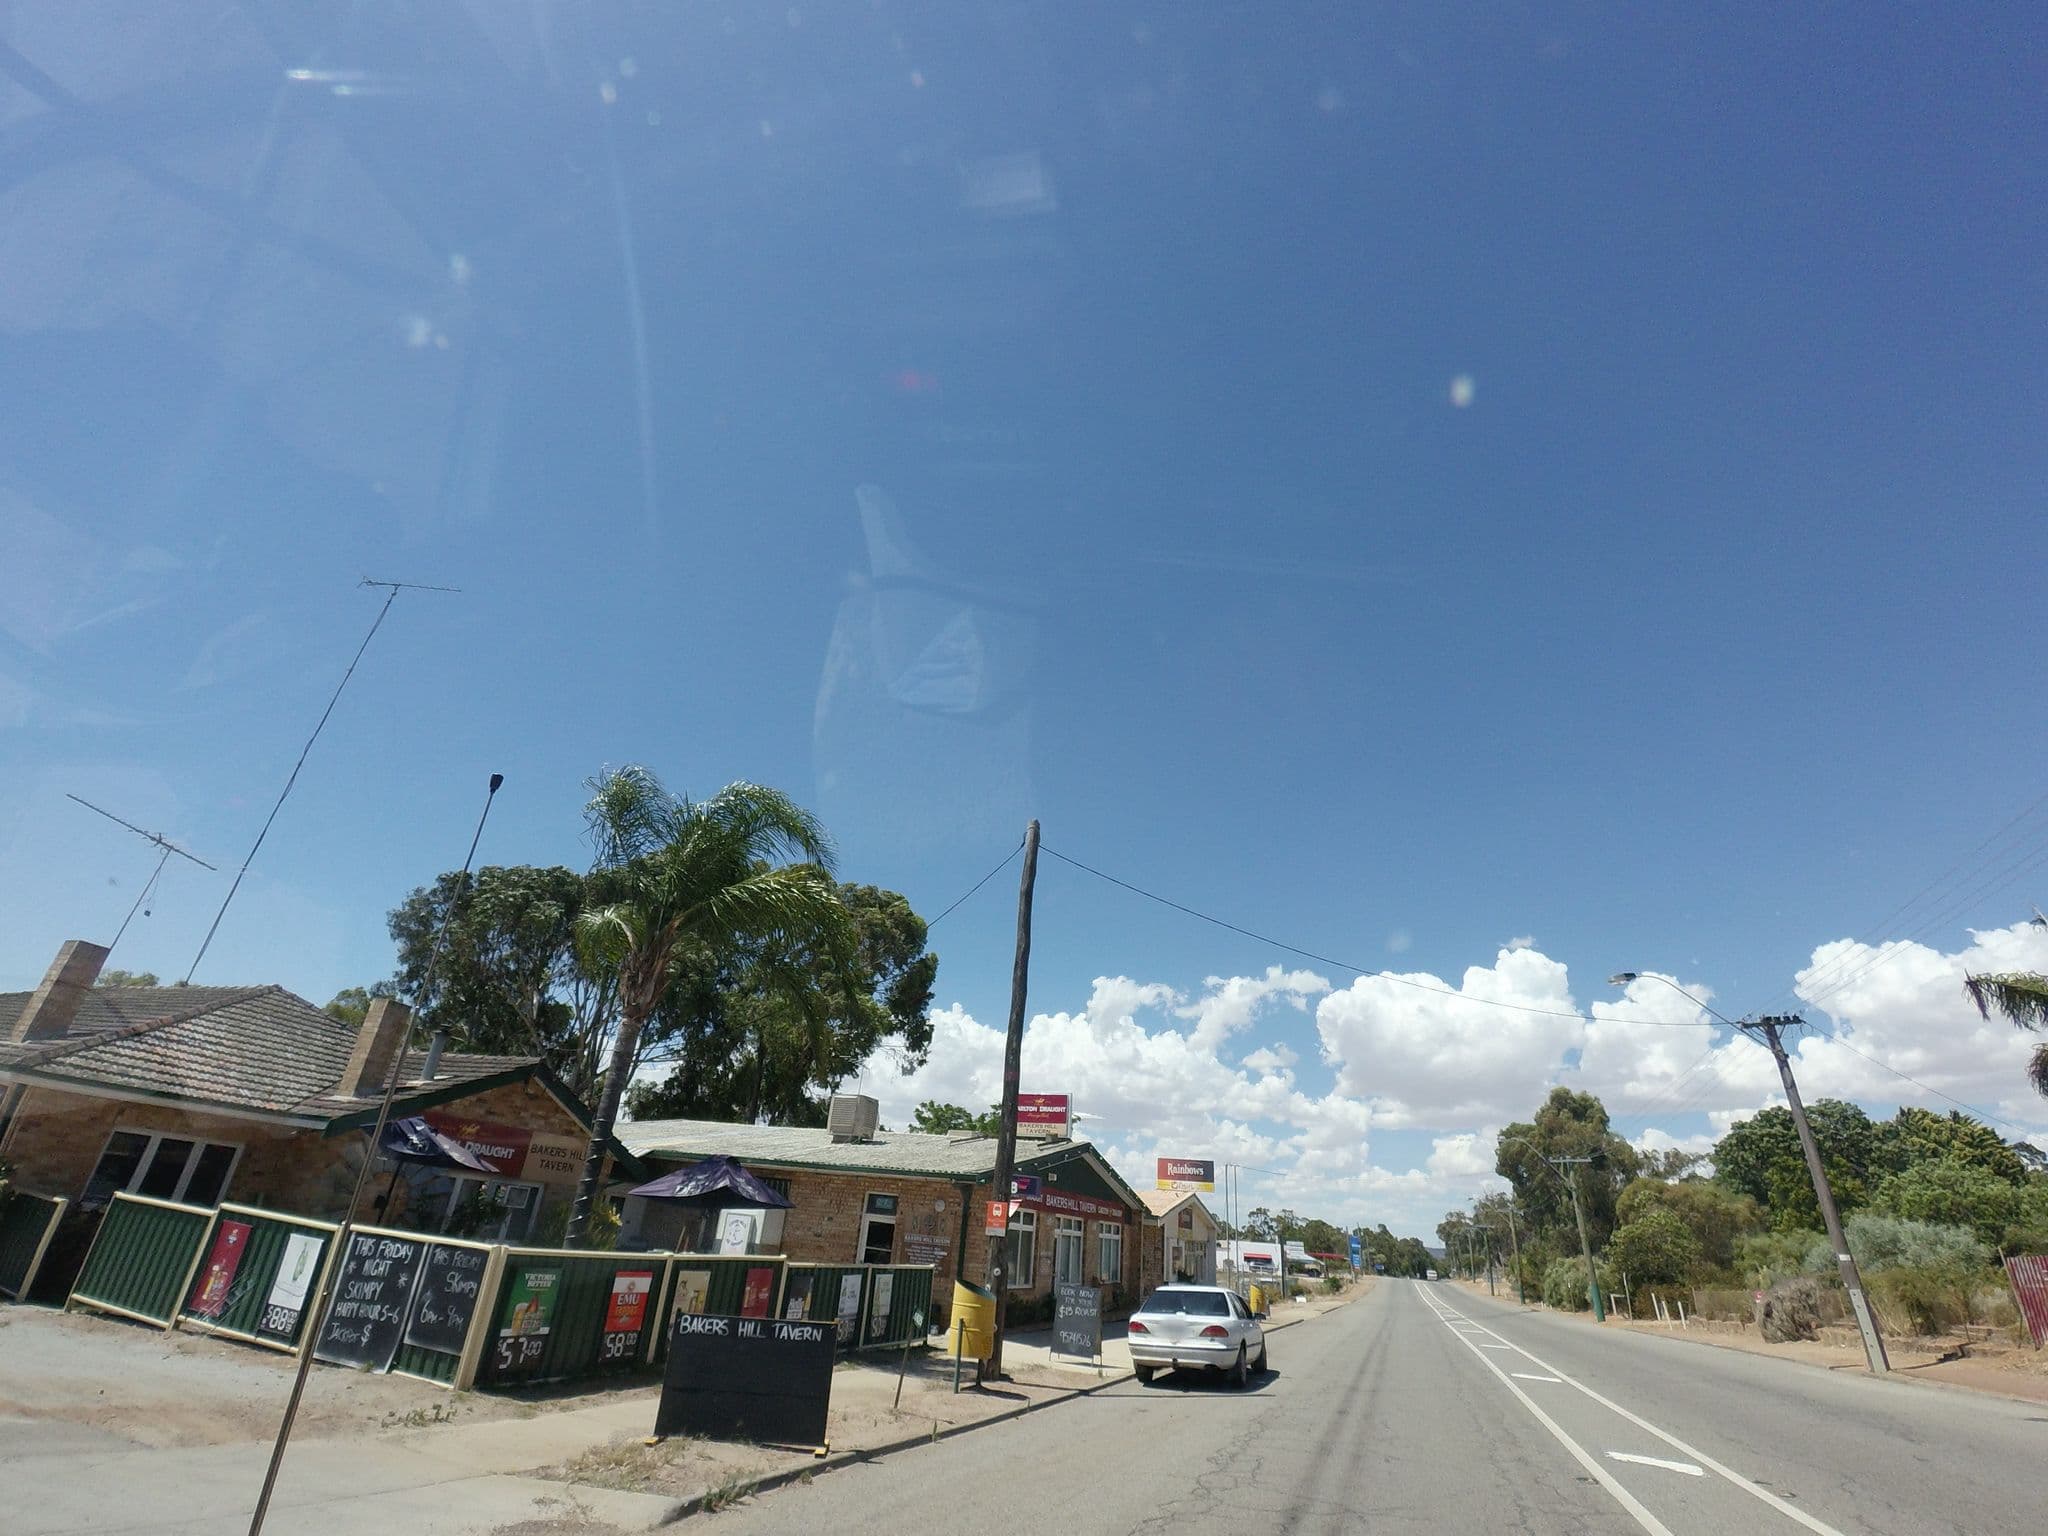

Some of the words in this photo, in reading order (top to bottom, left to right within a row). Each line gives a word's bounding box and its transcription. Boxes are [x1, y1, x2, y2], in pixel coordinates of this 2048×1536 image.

[464, 1141, 515, 1160] DRAUGHT
[531, 1143, 567, 1159] BAKERS
[539, 1159, 574, 1173] TAVERN
[1167, 1163, 1204, 1176] Rainbows
[1046, 1194, 1068, 1209] BAKERS
[355, 1237, 377, 1257] THIS
[376, 1240, 415, 1264] FRIDAY
[362, 1259, 393, 1277] NIGHT
[525, 1272, 556, 1281] VICTORIA
[344, 1280, 385, 1301] SKIMPY
[617, 1293, 641, 1306] EMU
[334, 1301, 358, 1319] HAPPY
[679, 1314, 730, 1337] BAKERS
[738, 1321, 766, 1338] HILL
[772, 1323, 823, 1343] TAVERN
